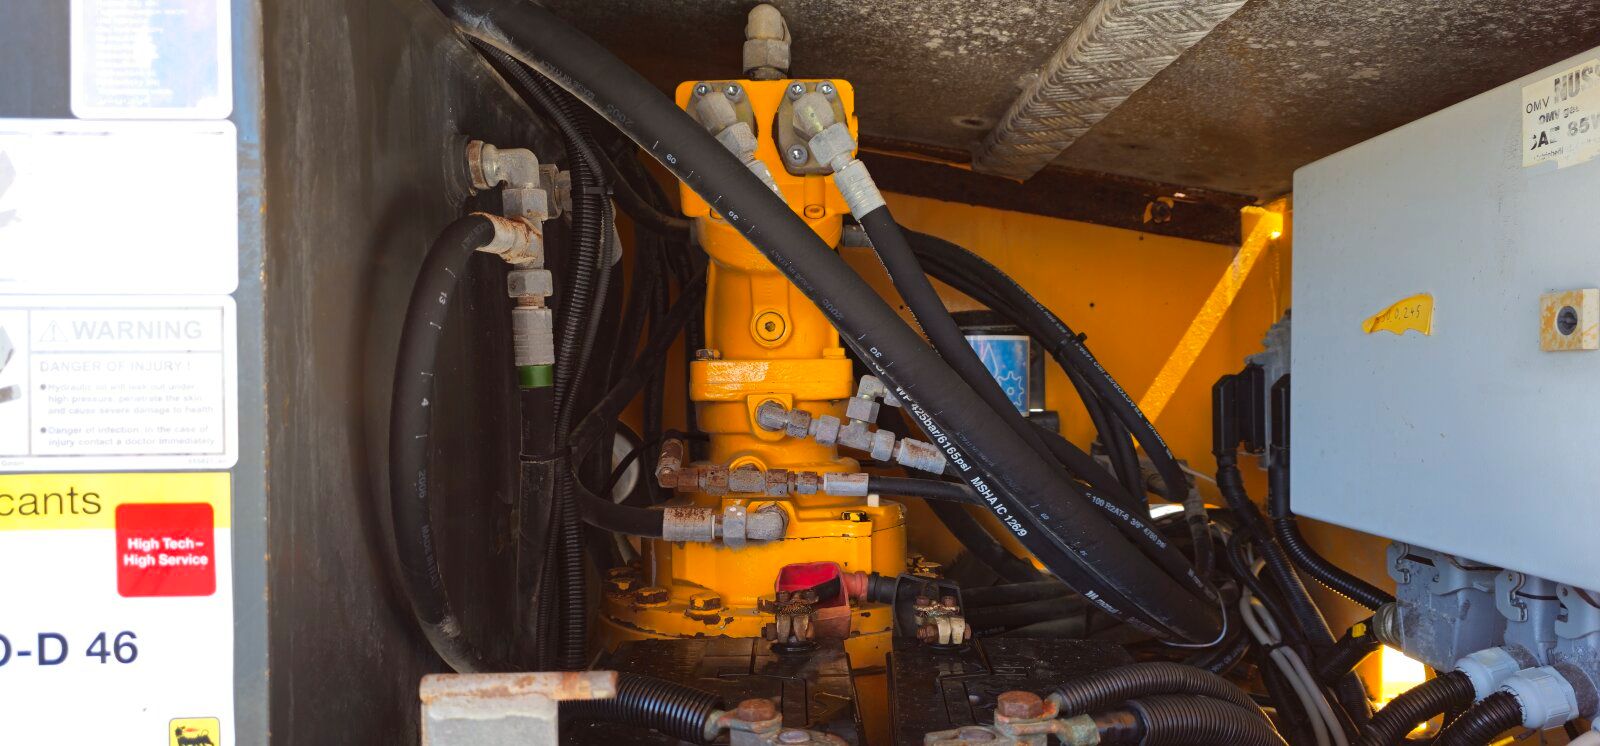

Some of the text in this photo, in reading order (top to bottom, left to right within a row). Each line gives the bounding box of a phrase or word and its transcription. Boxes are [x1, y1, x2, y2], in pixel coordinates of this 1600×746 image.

[1526, 96, 1550, 114] OMV
[72, 320, 202, 340] WARNING
[40, 360, 102, 372] DANGER
[106, 360, 125, 372] OF
[130, 360, 182, 372] INJURY
[48, 426, 82, 435] Danger
[48, 438, 74, 448] injury
[0, 486, 102, 516] cants
[970, 476, 996, 506] MSHA
[994, 503, 1008, 515] IC
[1004, 515, 1028, 537] 126/9
[128, 537, 159, 551] High
[124, 554, 208, 568] High Service
[86, 630, 138, 664] 46
